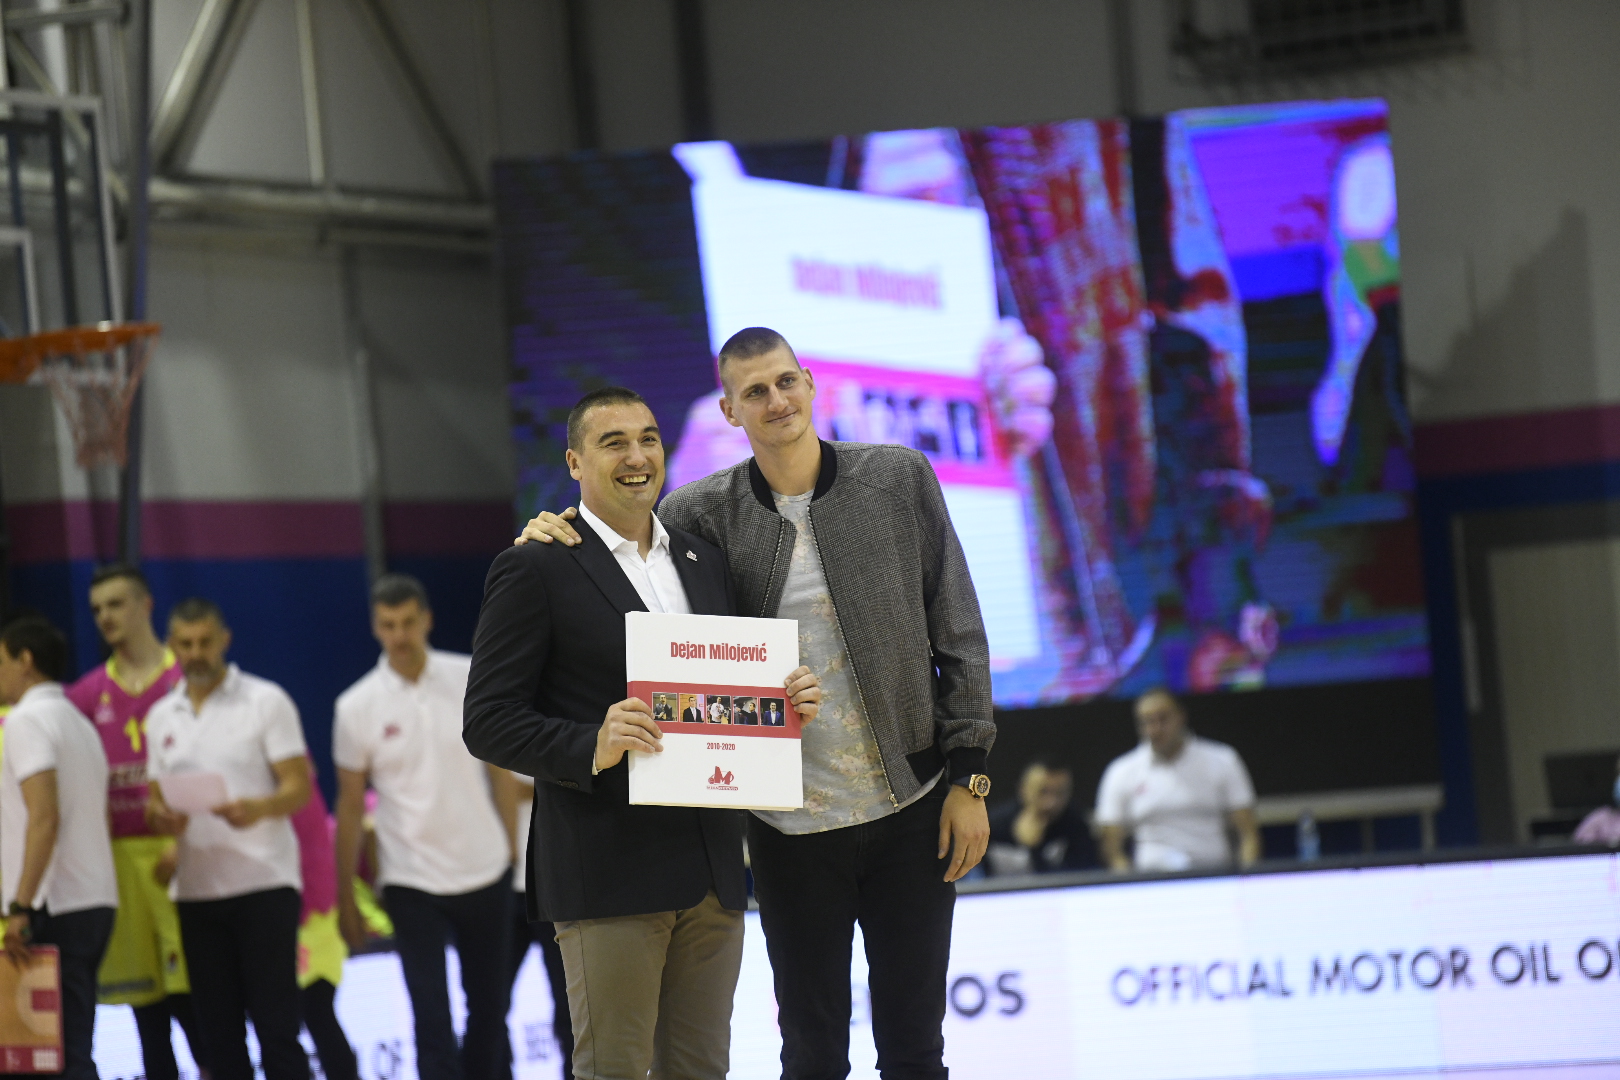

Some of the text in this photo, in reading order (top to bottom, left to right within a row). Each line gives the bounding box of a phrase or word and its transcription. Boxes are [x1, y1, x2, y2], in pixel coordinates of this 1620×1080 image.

[670, 641, 767, 662] Dejan Milojević
[706, 742, 736, 751] 2010-2020
[1111, 938, 1620, 1006] OFFICIAL MOTOR OIL O
